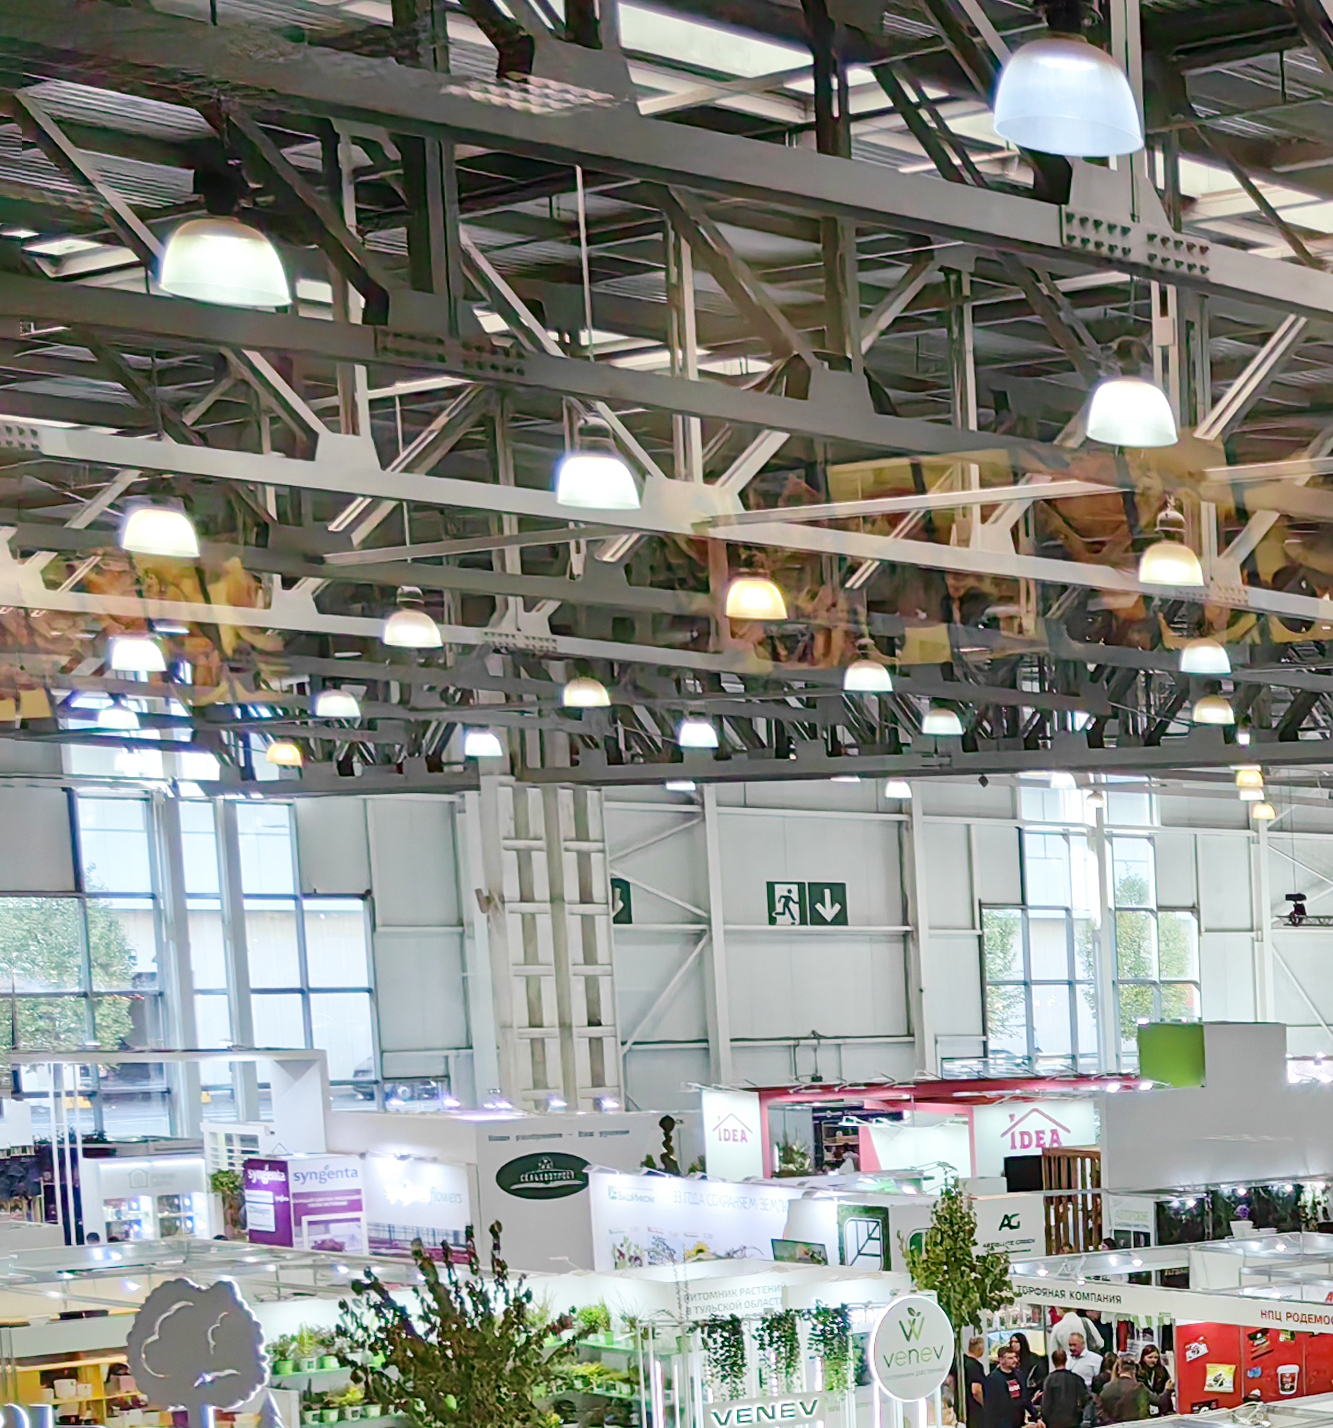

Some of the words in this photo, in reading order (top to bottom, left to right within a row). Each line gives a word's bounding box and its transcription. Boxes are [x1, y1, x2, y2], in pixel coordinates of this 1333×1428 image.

[717, 1128, 748, 1143] IDEA
[1010, 1129, 1062, 1151] IDEA
[247, 1166, 286, 1184] syngenta
[293, 1167, 359, 1185] syngenta
[1016, 1285, 1066, 1299] ТОРФЯНАЯ
[1069, 1290, 1122, 1304] КОМПАНИЯ
[1260, 1309, 1283, 1321] НПЦ
[883, 1343, 944, 1369] venev
[711, 1399, 818, 1427] VENEV
